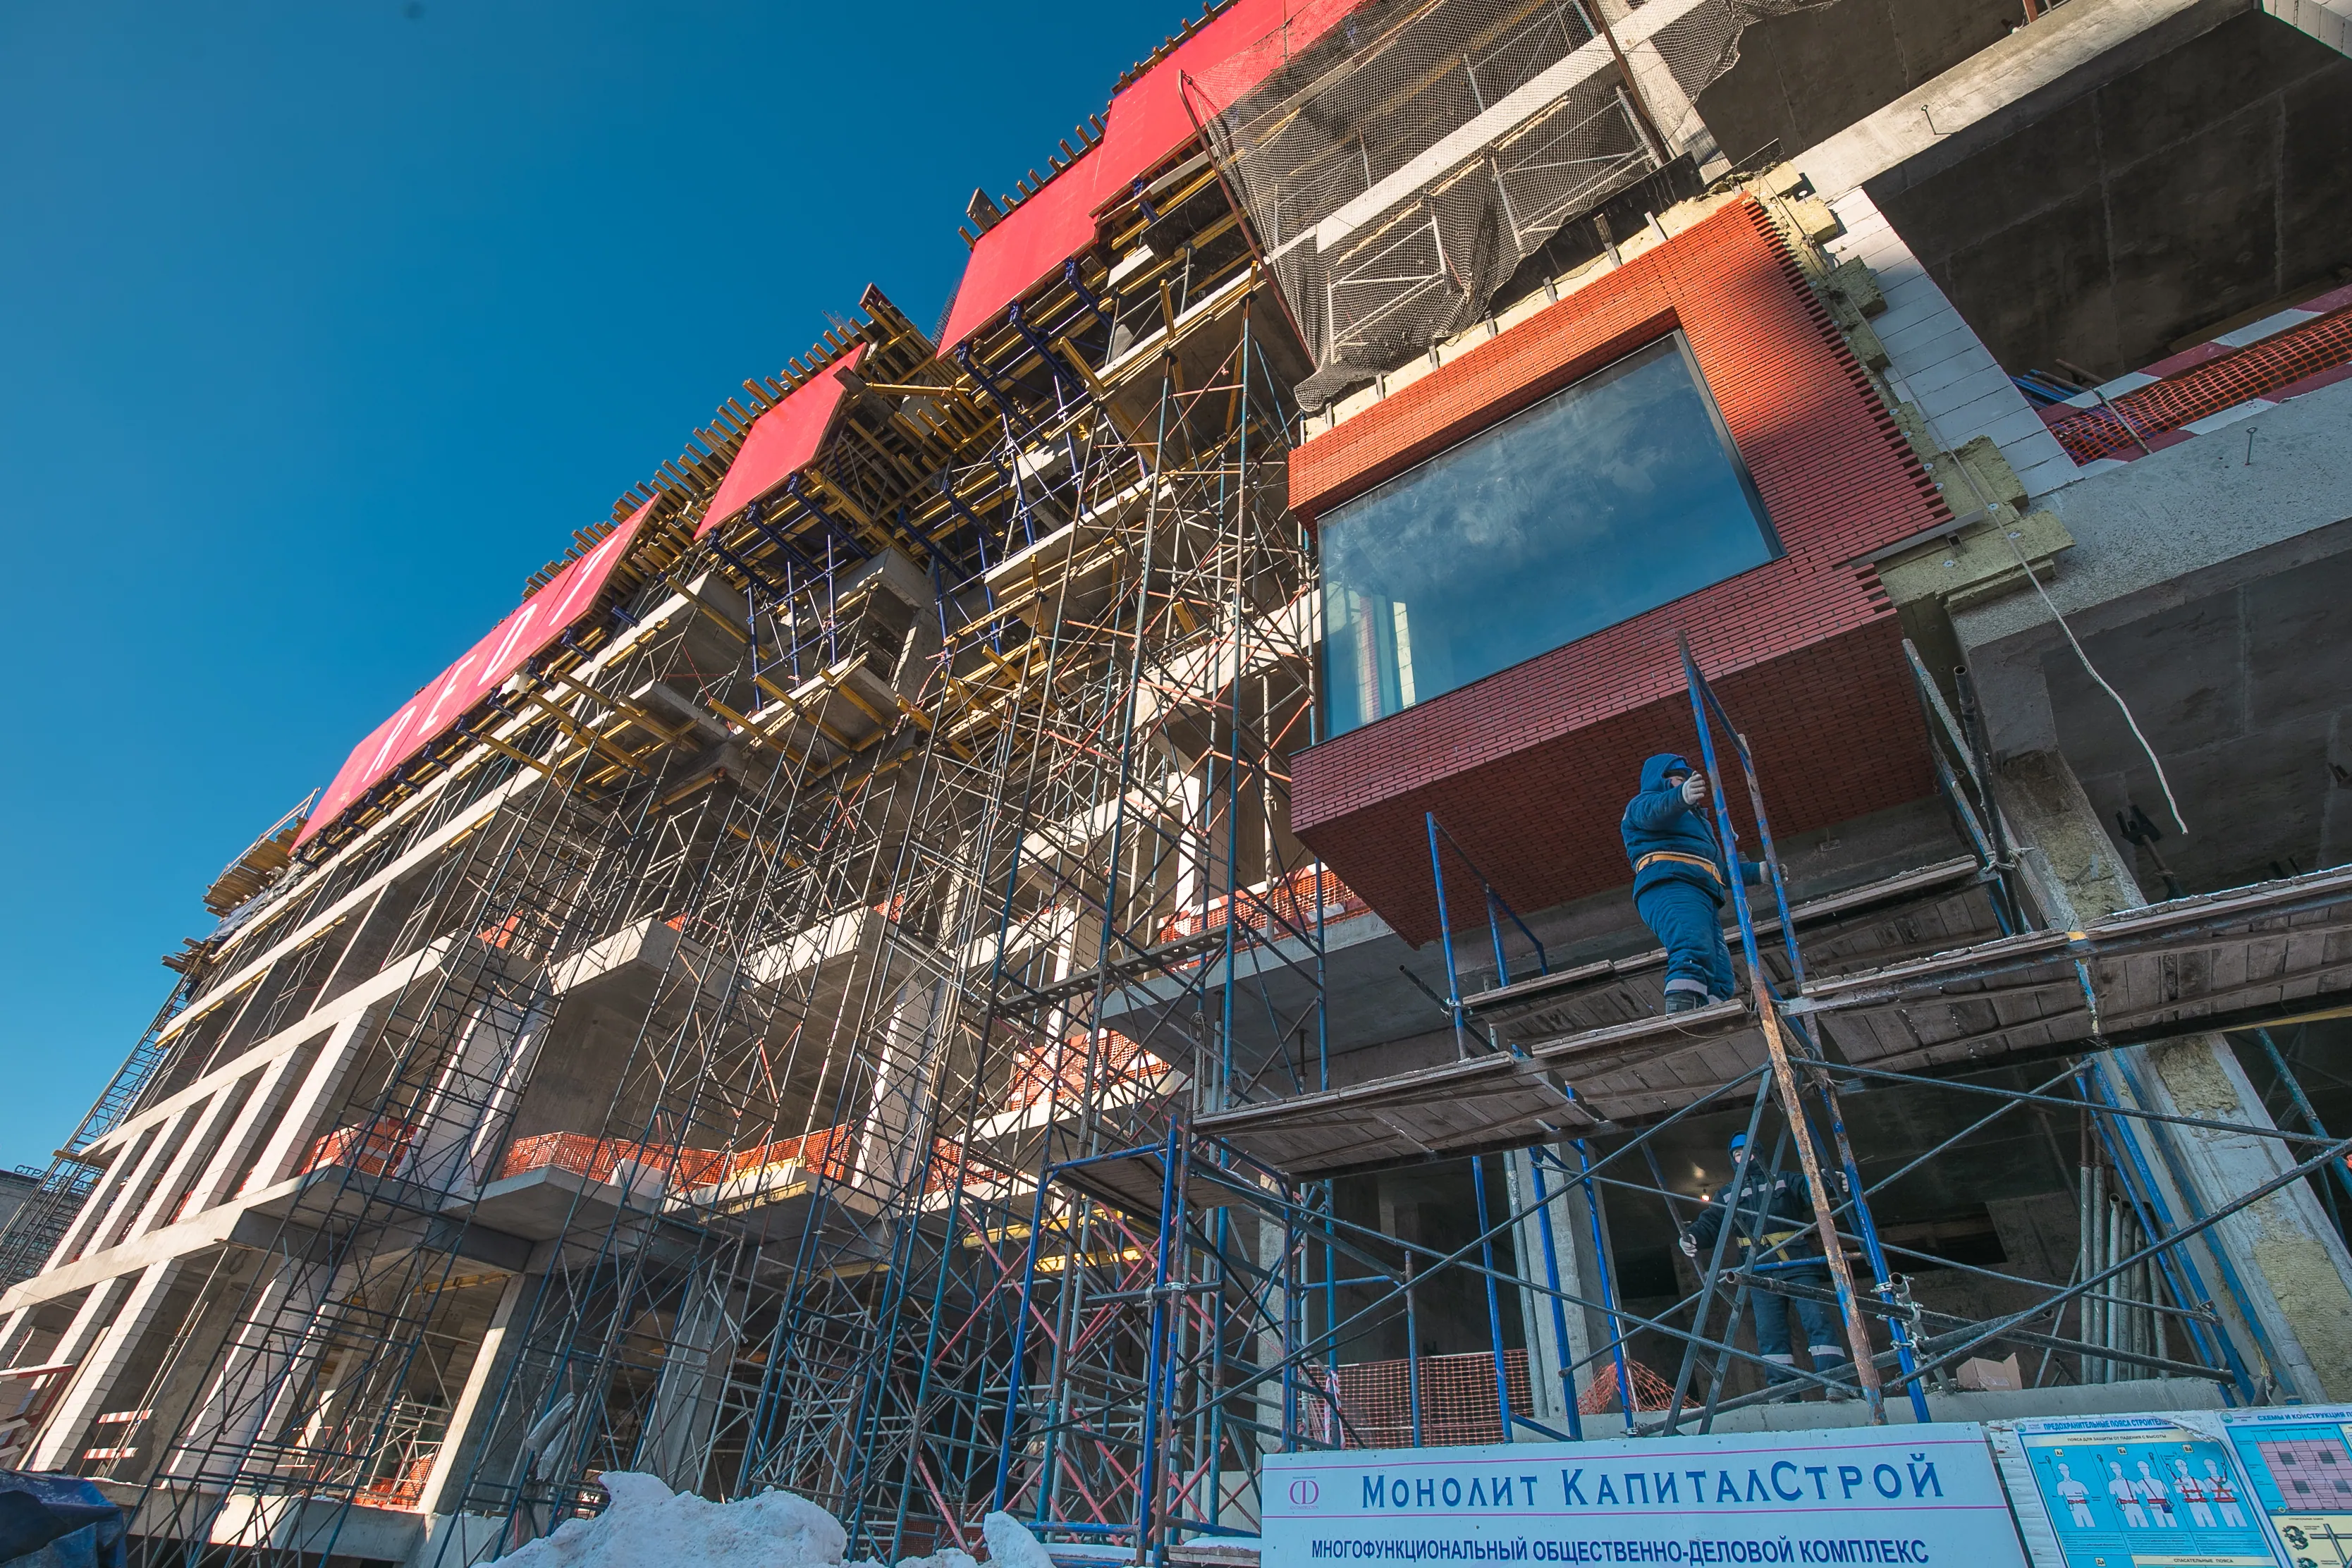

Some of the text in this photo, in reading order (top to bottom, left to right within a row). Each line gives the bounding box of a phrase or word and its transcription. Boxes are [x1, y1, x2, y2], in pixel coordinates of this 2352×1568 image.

[2291, 1411, 2346, 1419] КОНСТРУКЦИЯ
[2043, 1420, 2110, 1431] ПРЕДОХРАНИТЕЛЬНЫЕ
[2110, 1419, 2131, 1428] ПОЯСА
[1311, 1535, 1930, 1567] МНОГОФУНКЦИОНАЛЬНЫЙ ОБЩЕСТВЕННО-ДЕЛОВОЙ КОМПЛЕКС
